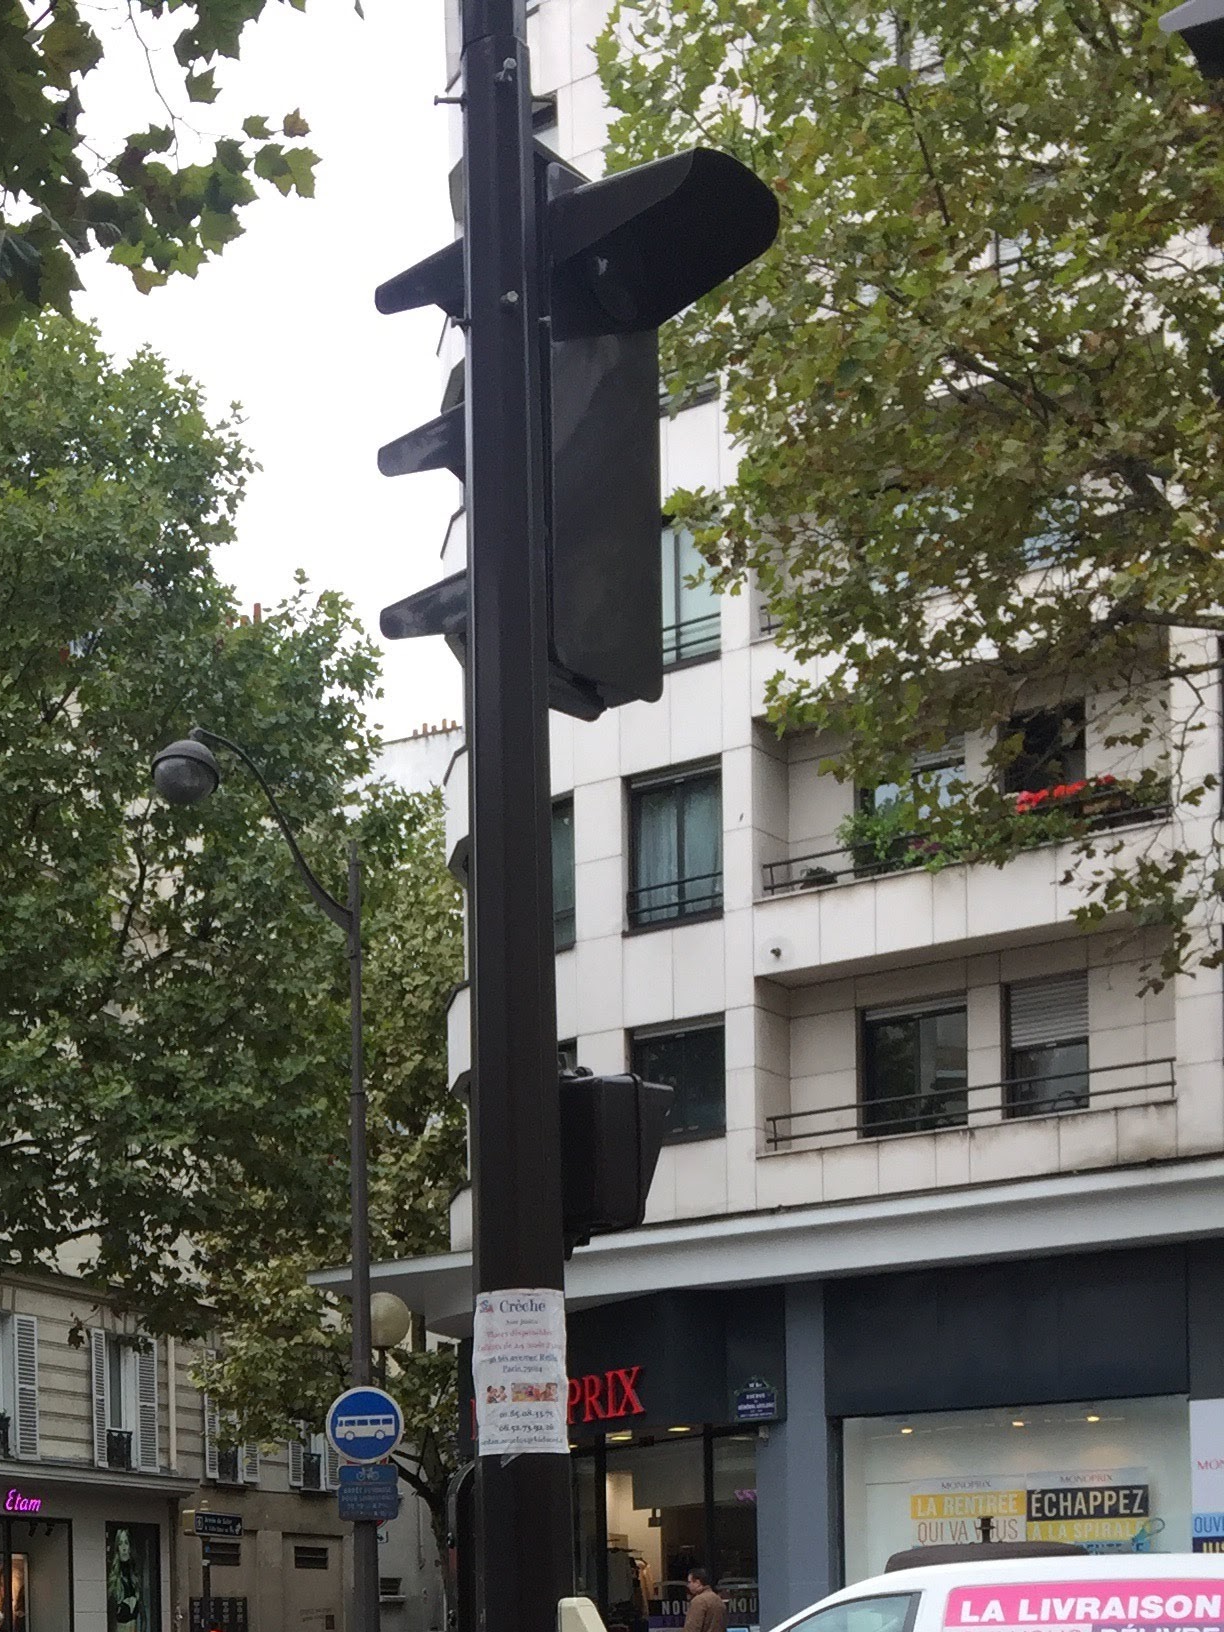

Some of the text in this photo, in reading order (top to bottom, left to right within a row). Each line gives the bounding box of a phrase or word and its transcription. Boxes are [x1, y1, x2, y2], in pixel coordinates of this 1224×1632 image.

[499, 1299, 546, 1313] Crèche
[941, 1479, 992, 1490] MONOPRIX
[1060, 1473, 1113, 1484] MONOPRIX
[5, 1488, 42, 1512] Etam
[917, 1492, 1018, 1517] LA RENTRÉE
[1031, 1489, 1145, 1518] ÉCHAPPEZ
[917, 1518, 1018, 1545] QUI VA VUS
[1049, 1522, 1067, 1540] LA
[1194, 1516, 1224, 1533] OUV
[960, 1594, 1222, 1623] LA LIVRAISON
